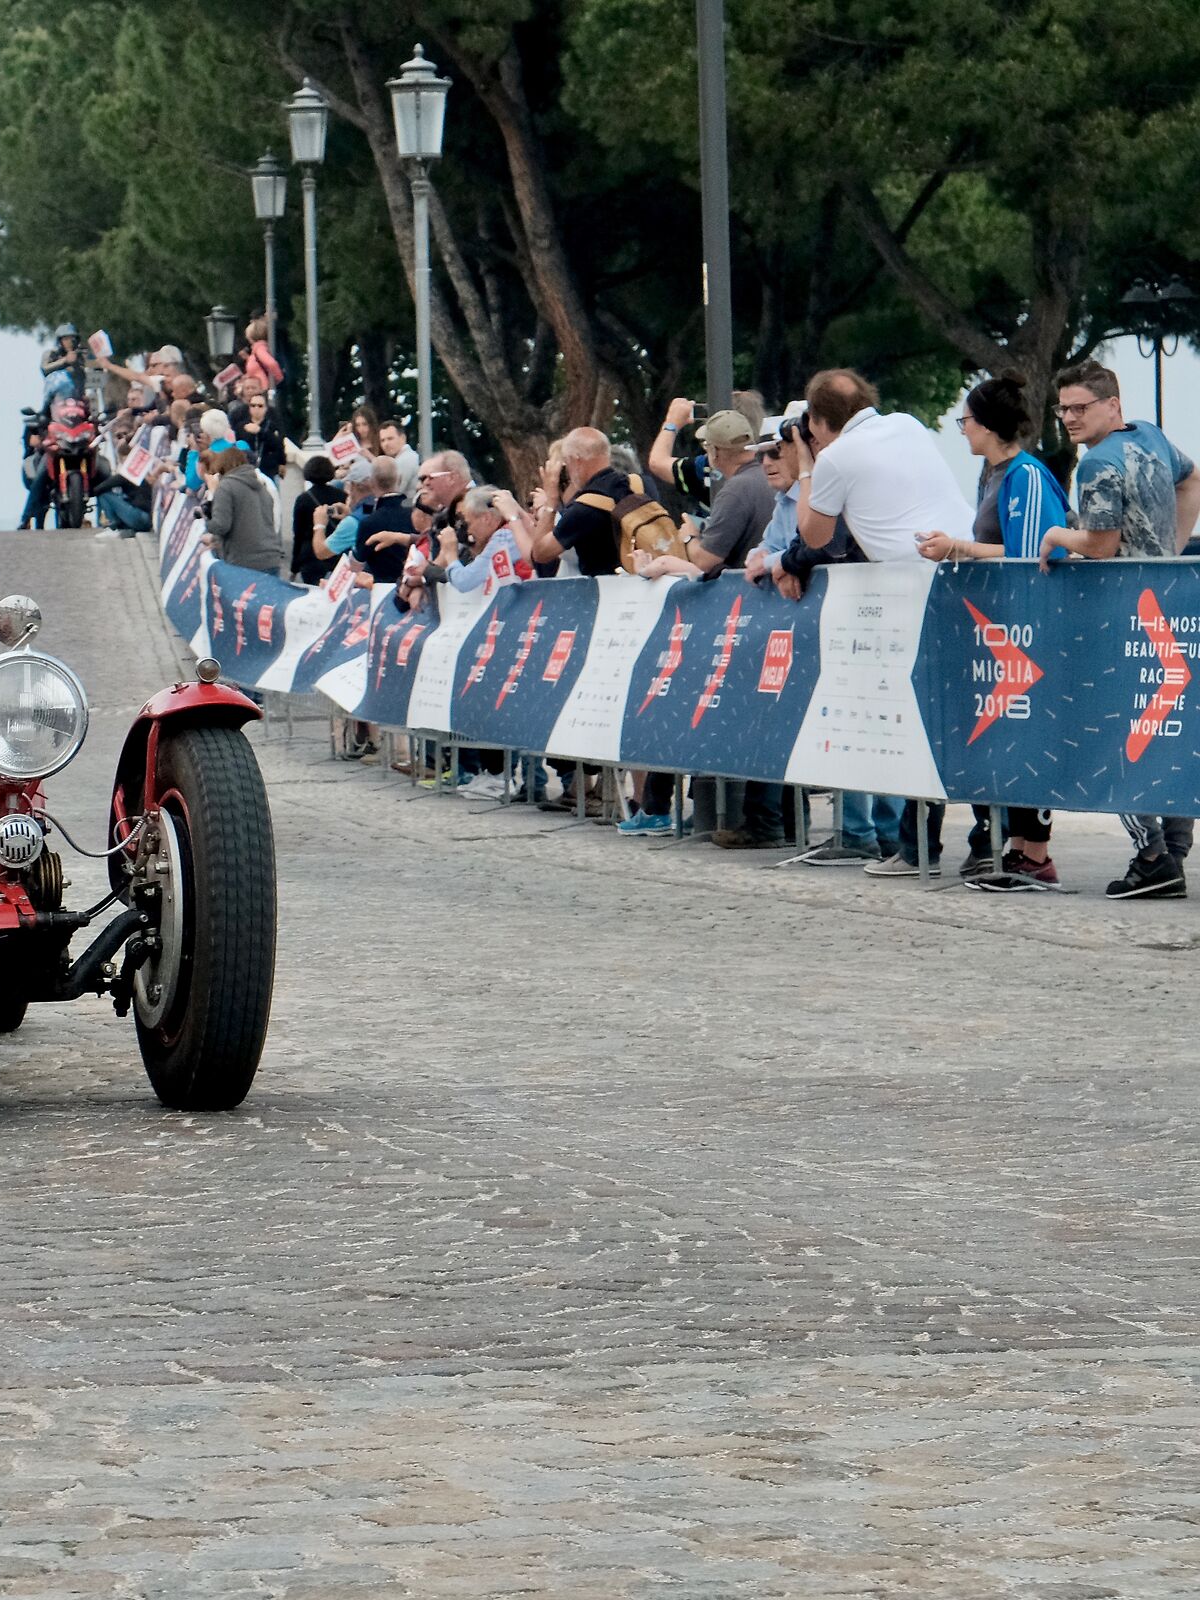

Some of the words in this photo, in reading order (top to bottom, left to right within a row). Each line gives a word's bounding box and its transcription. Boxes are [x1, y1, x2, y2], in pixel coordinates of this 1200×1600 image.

[1130, 615, 1165, 632] THE
[974, 624, 1033, 647] 1000
[973, 660, 1033, 683] MIGLIA
[1140, 668, 1185, 684] RACE
[974, 694, 1031, 719] 2018
[1134, 693, 1147, 709] IN
[1152, 694, 1185, 710] THE
[1130, 719, 1182, 736] WORLD
